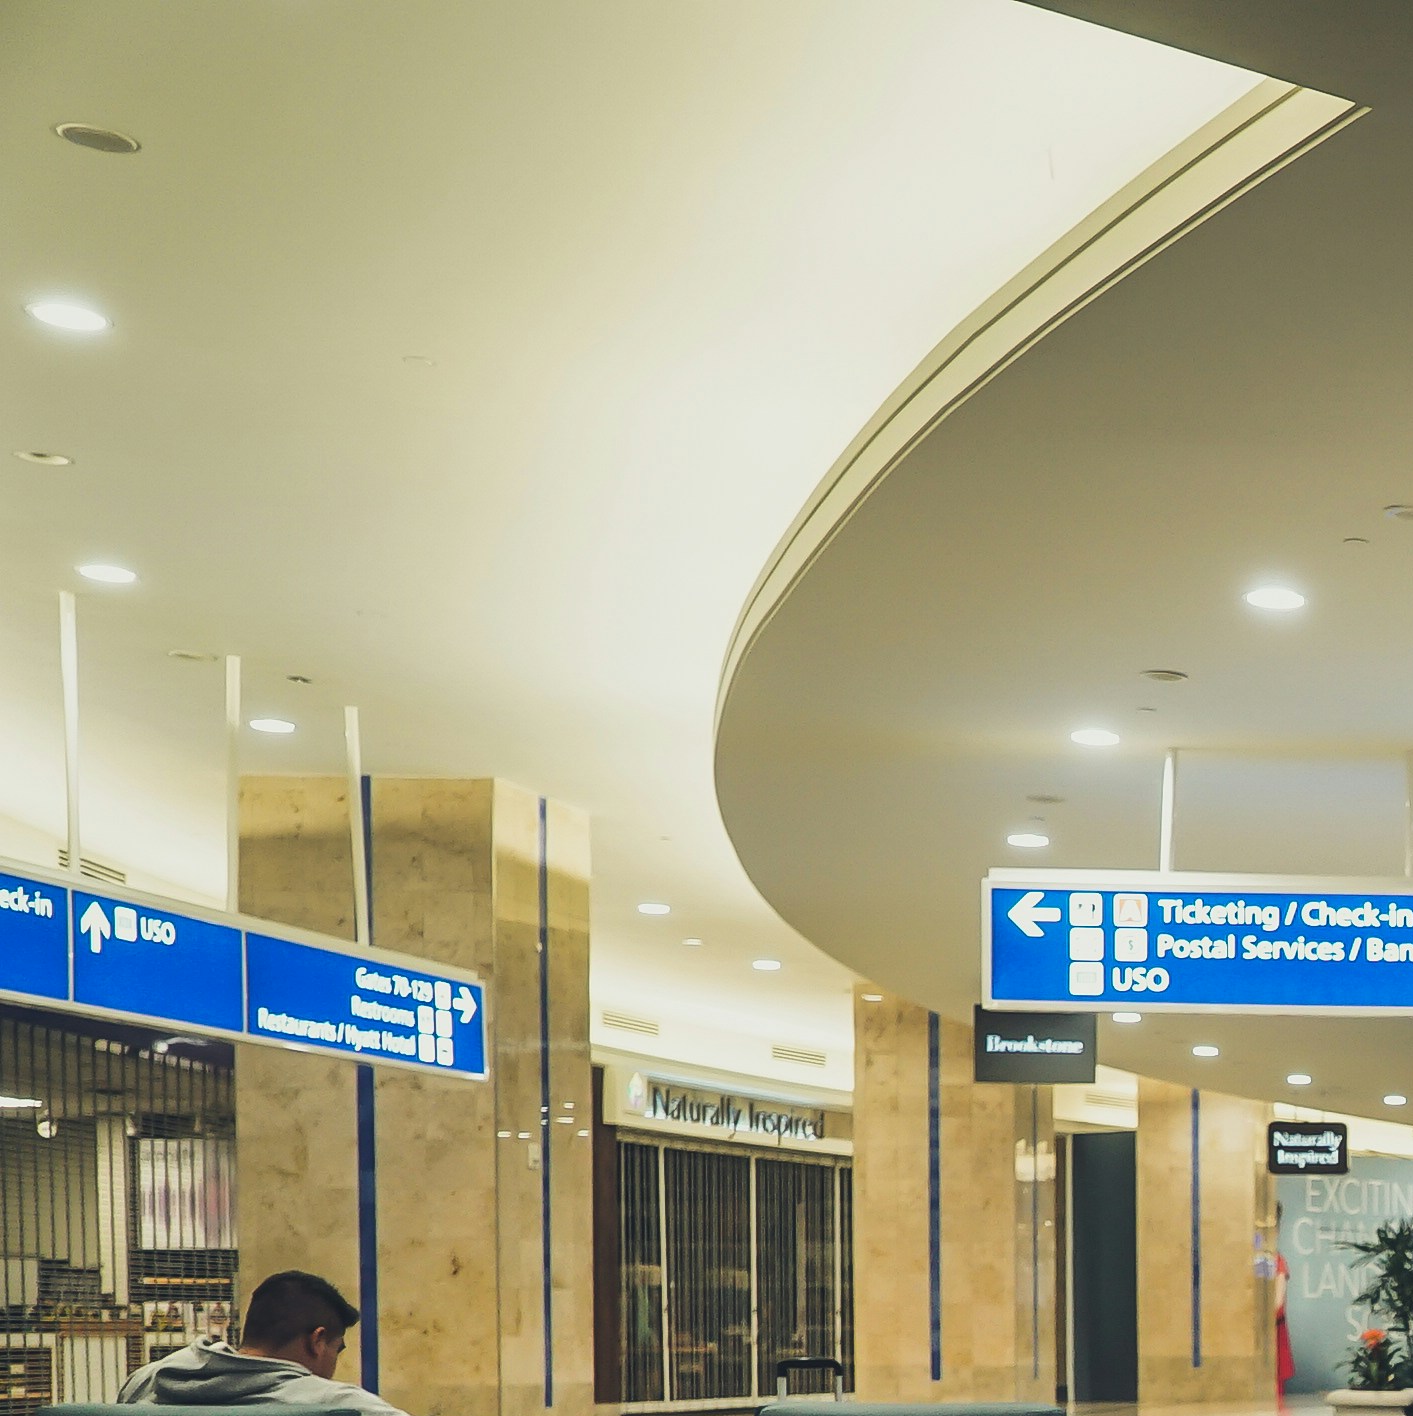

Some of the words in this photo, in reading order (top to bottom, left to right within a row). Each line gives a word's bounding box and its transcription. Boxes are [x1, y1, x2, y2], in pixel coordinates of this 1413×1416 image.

[1158, 899, 1280, 929] Ticketing
[1285, 901, 1297, 926] /
[141, 917, 176, 945] USO
[1157, 934, 1236, 959] Postal
[1242, 935, 1345, 961] Services
[1349, 937, 1362, 962] /
[355, 966, 393, 994] Gates
[1113, 967, 1170, 992] USO
[351, 995, 416, 1027] Restrooms
[257, 1007, 337, 1042] Restaurants
[345, 1024, 381, 1051] Hyatt
[382, 1030, 416, 1056] Hotel
[652, 1087, 742, 1139] Naturally
[749, 1103, 825, 1145] Inspired
